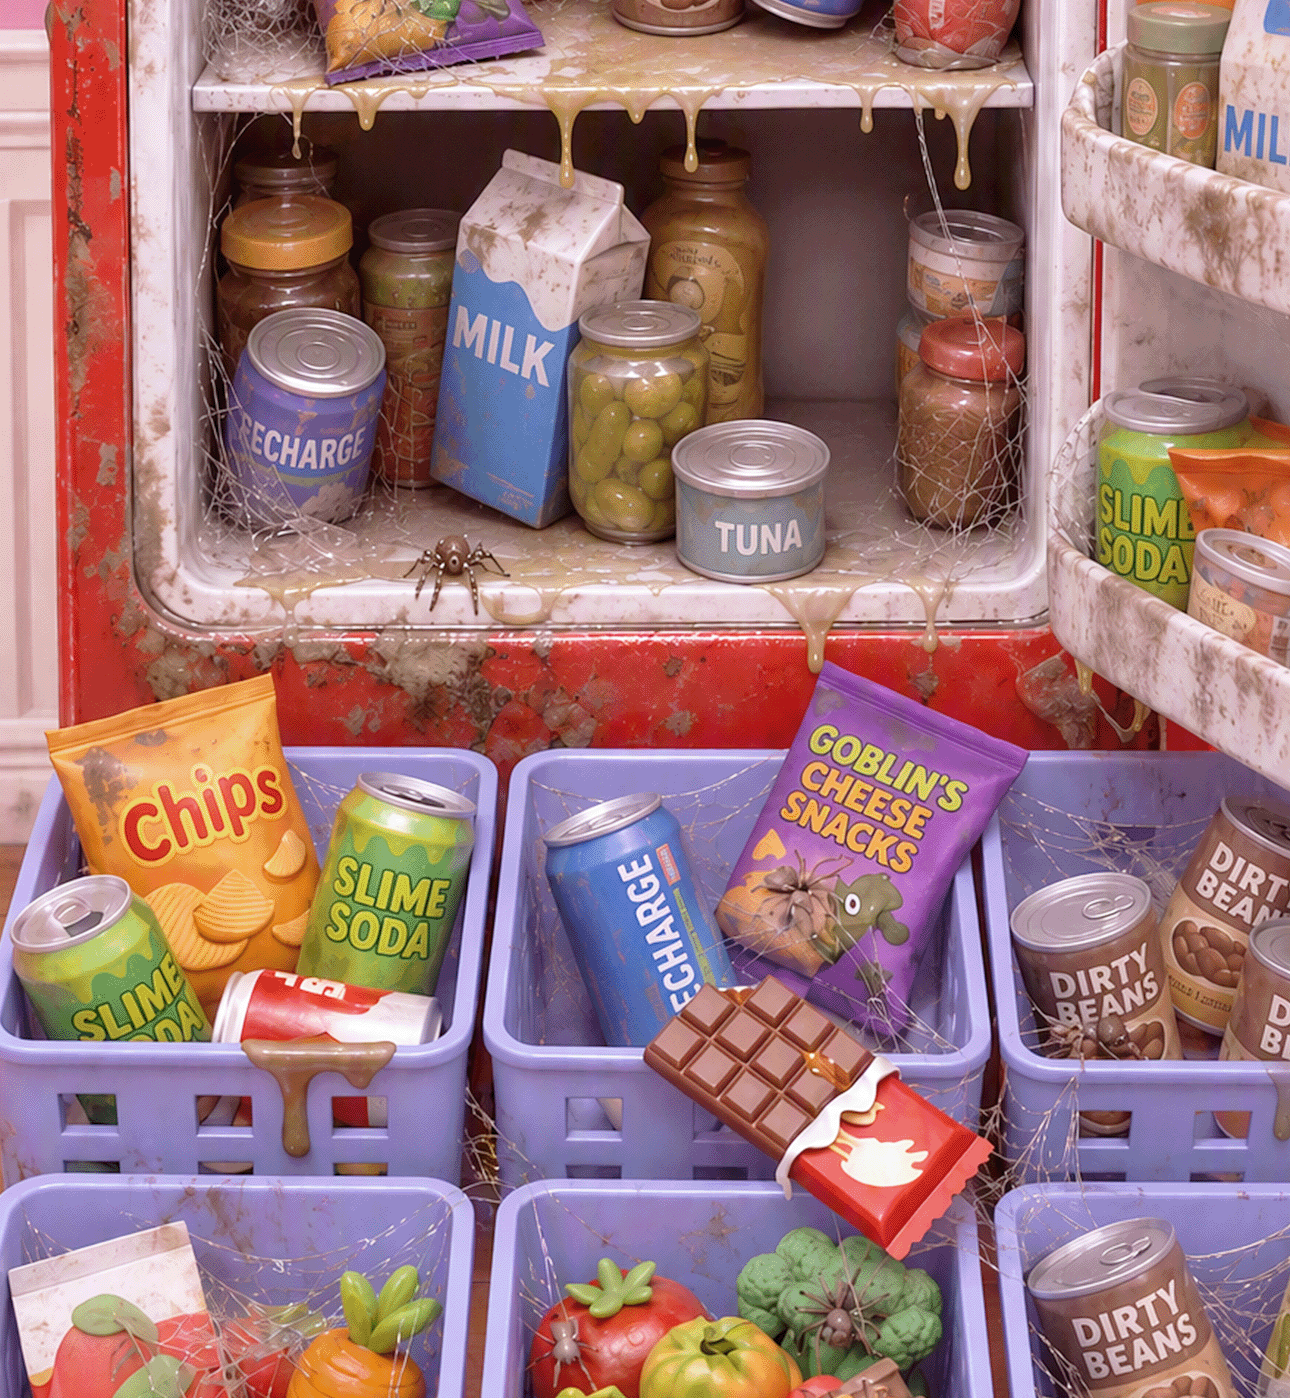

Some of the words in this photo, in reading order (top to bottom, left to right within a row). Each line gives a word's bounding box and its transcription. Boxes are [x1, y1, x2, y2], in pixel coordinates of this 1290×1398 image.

[1224, 104, 1290, 167] MIL
[452, 304, 557, 388] MILK
[715, 519, 802, 557] TUNA
[1099, 526, 1190, 584] SODA
[800, 761, 932, 839] CHEESE
[809, 724, 969, 812] GOBLIN'S
[123, 768, 282, 862] Chips
[780, 792, 918, 874] SNACKS
[333, 857, 450, 919] SLIME
[1209, 841, 1289, 902] DIRT
[326, 902, 429, 960] SODA
[617, 854, 702, 1014] ECHARGE
[72, 952, 185, 1041] SLIME
[1050, 943, 1147, 1000] DIRTY
[1072, 1279, 1179, 1348] DIRTY
[1083, 1313, 1197, 1379] BEANS
